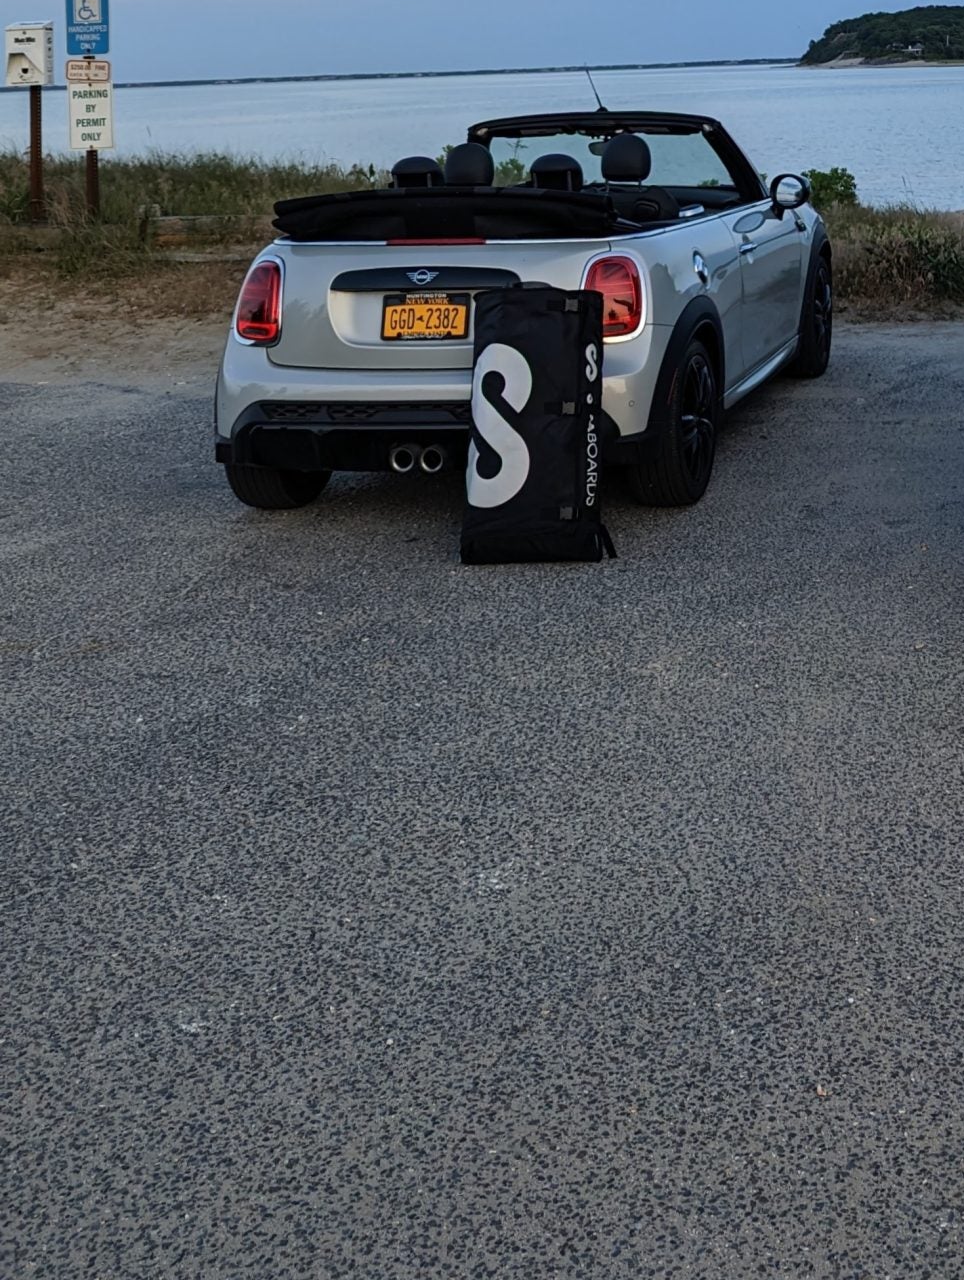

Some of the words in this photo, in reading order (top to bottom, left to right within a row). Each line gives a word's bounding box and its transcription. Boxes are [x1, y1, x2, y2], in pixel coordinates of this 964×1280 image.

[80, 42, 96, 50] ONLY
[72, 89, 109, 99] PARKING
[85, 104, 96, 113] BY
[76, 118, 107, 128] PERMIT
[81, 132, 102, 142] ONLY
